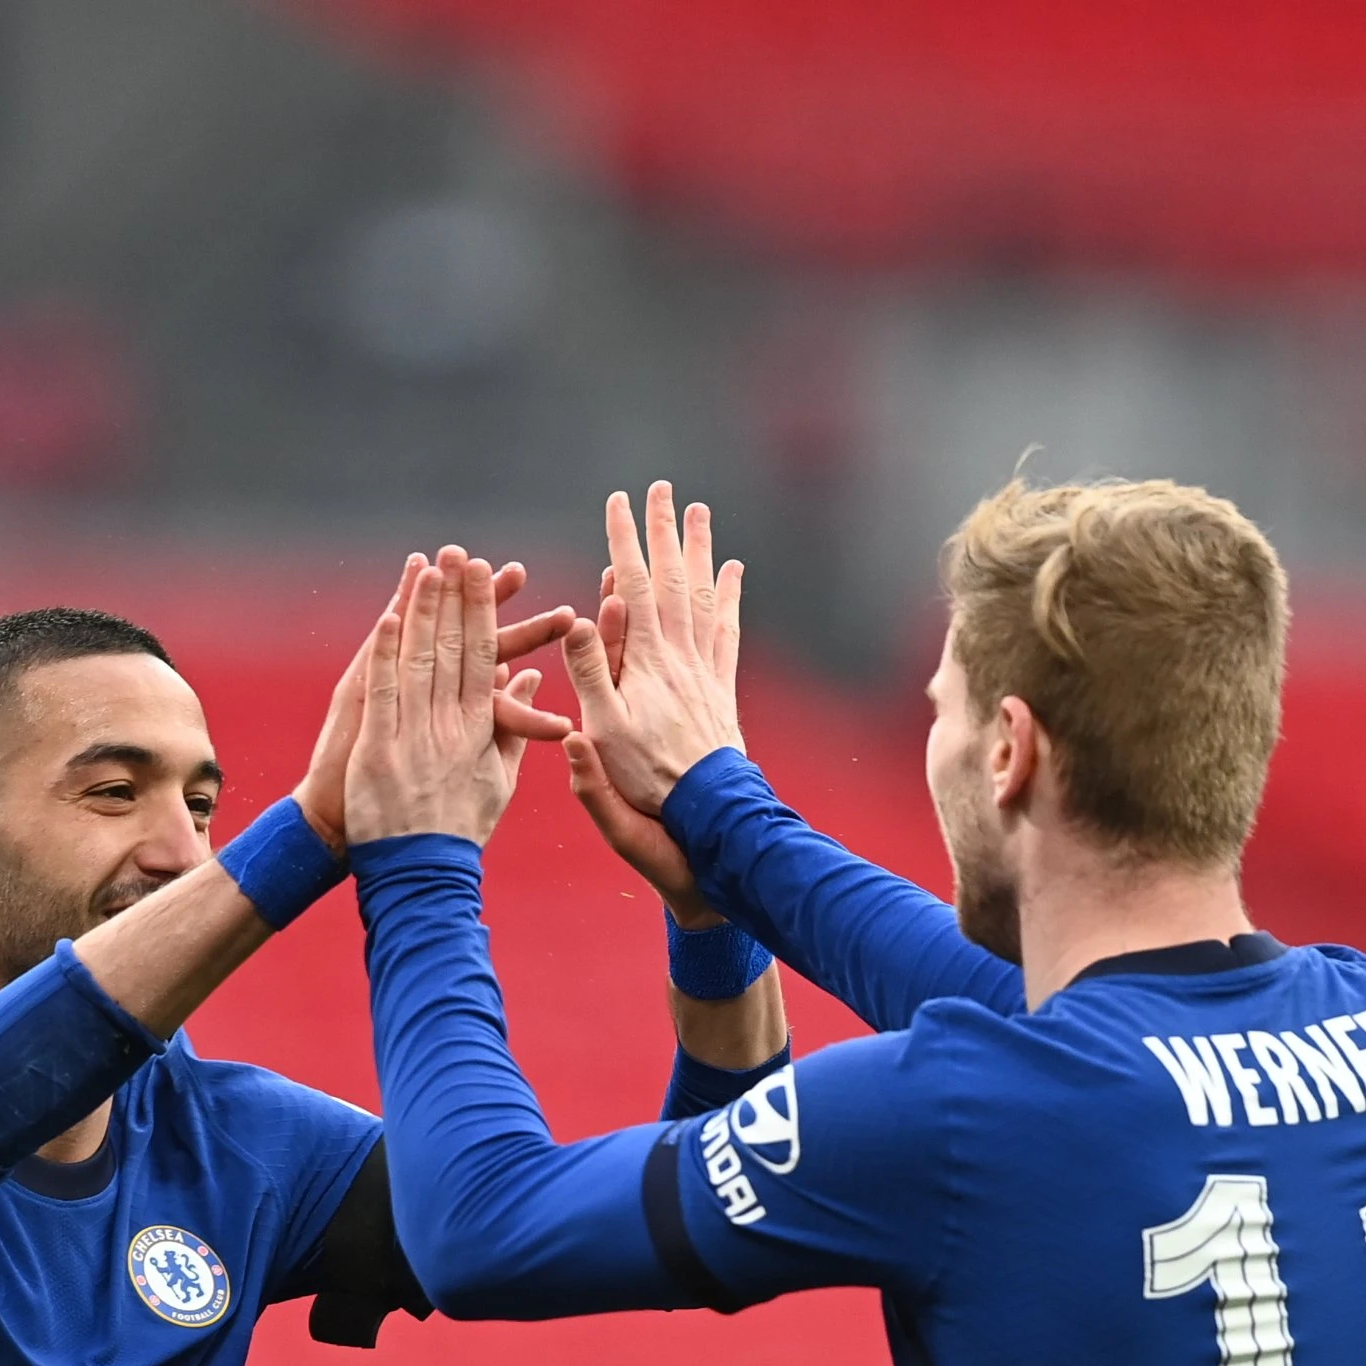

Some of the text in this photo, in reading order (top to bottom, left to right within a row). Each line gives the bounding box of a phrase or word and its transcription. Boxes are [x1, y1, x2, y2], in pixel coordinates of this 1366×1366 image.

[699, 1109, 767, 1225] NDAI
[133, 1229, 184, 1261] CHELSEA
[171, 1289, 225, 1321] FOOTBALL CLUB
